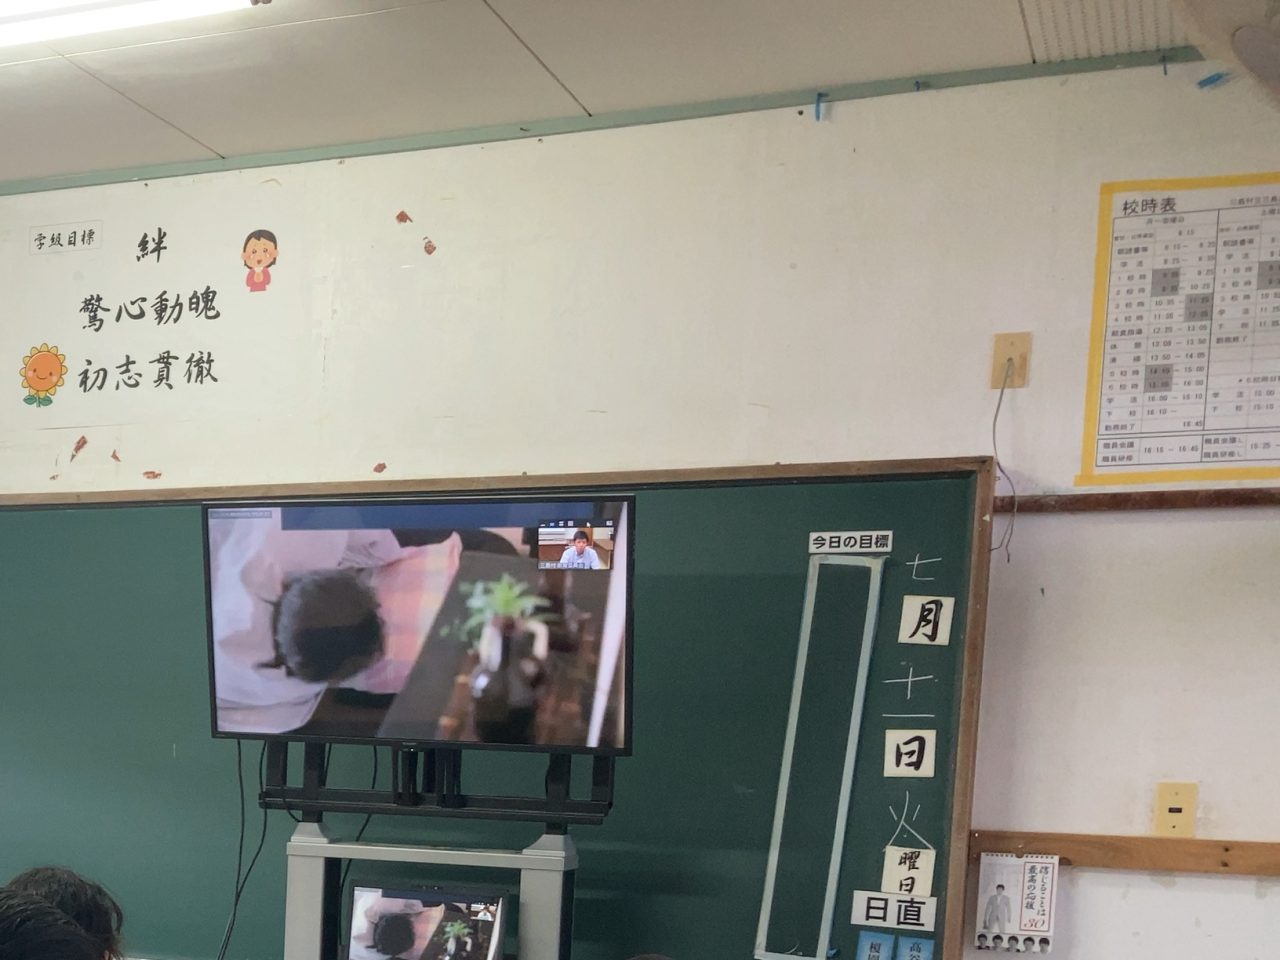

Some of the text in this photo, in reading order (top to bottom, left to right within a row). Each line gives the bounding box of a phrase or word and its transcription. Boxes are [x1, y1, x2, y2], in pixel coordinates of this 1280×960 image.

[1122, 197, 1176, 215] 校時表
[34, 229, 95, 249] 学級目標
[136, 227, 167, 263] 絆
[79, 285, 220, 332] 驚心動魄
[77, 350, 218, 393] 初志貫徹
[812, 534, 890, 549] 今日の目標
[865, 896, 926, 927] 日直
